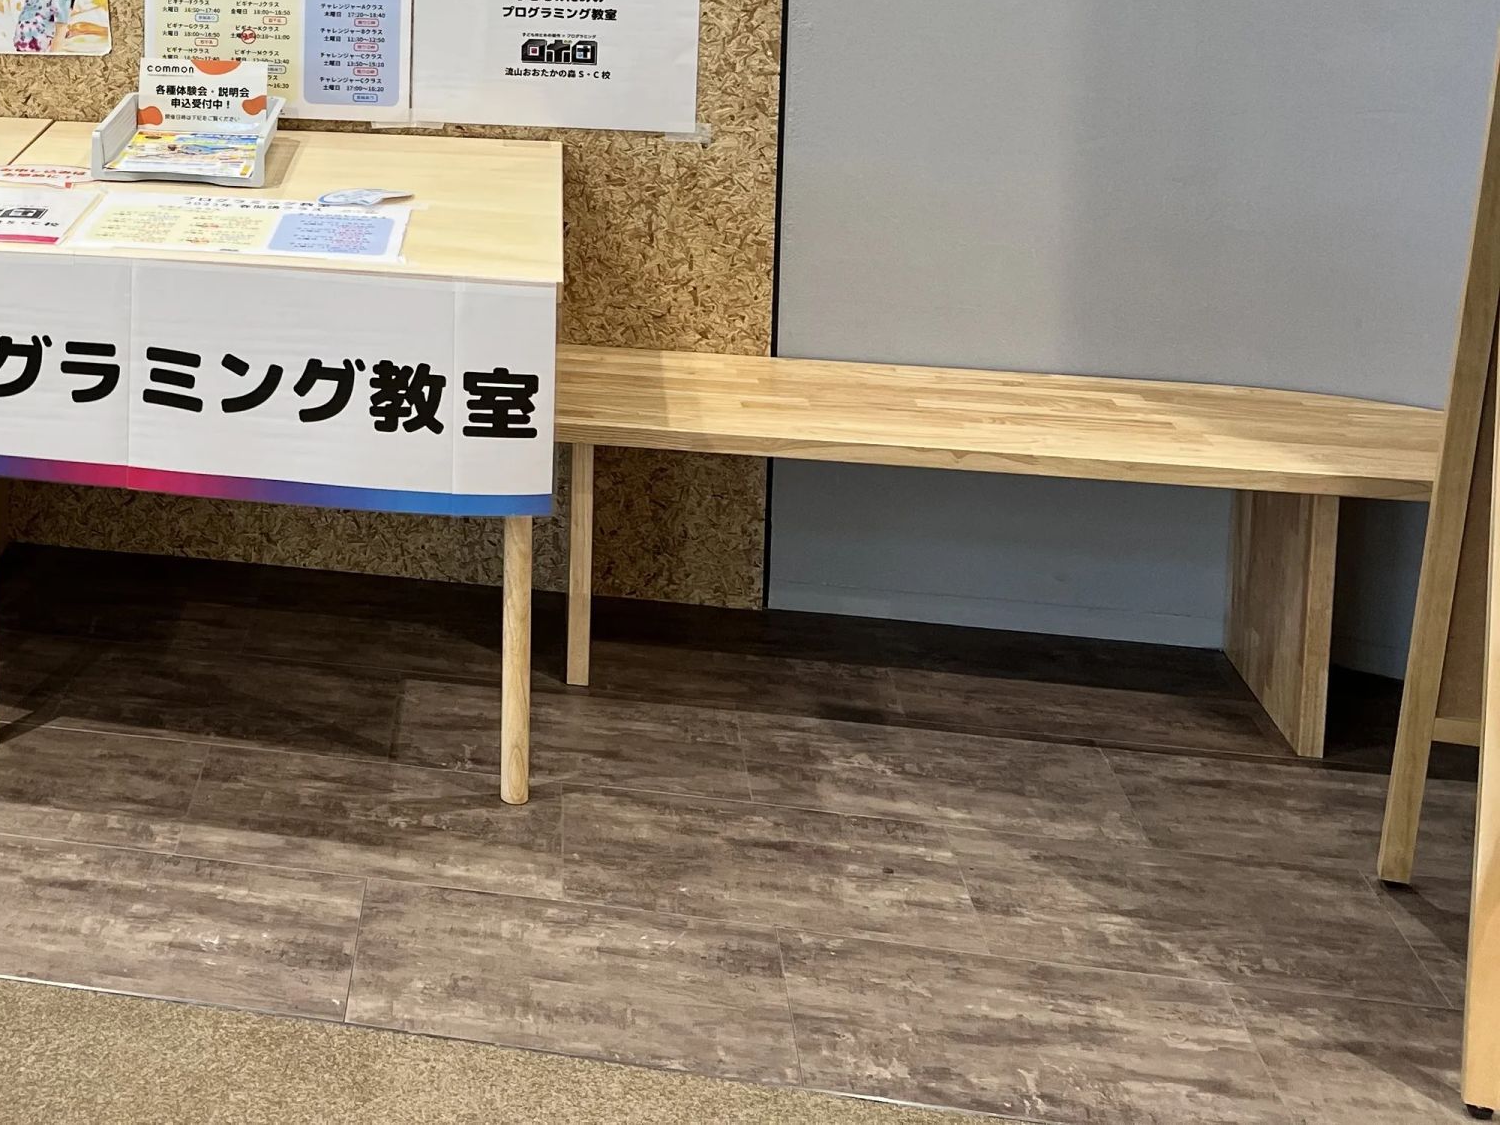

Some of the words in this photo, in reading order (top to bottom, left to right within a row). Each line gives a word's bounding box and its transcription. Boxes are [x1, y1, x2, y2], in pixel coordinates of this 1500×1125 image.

[502, 6, 618, 22] プログラミング教室
[147, 64, 194, 74] common
[155, 85, 250, 98] 各種体験会・説明会
[171, 98, 231, 110] 申込受付中！
